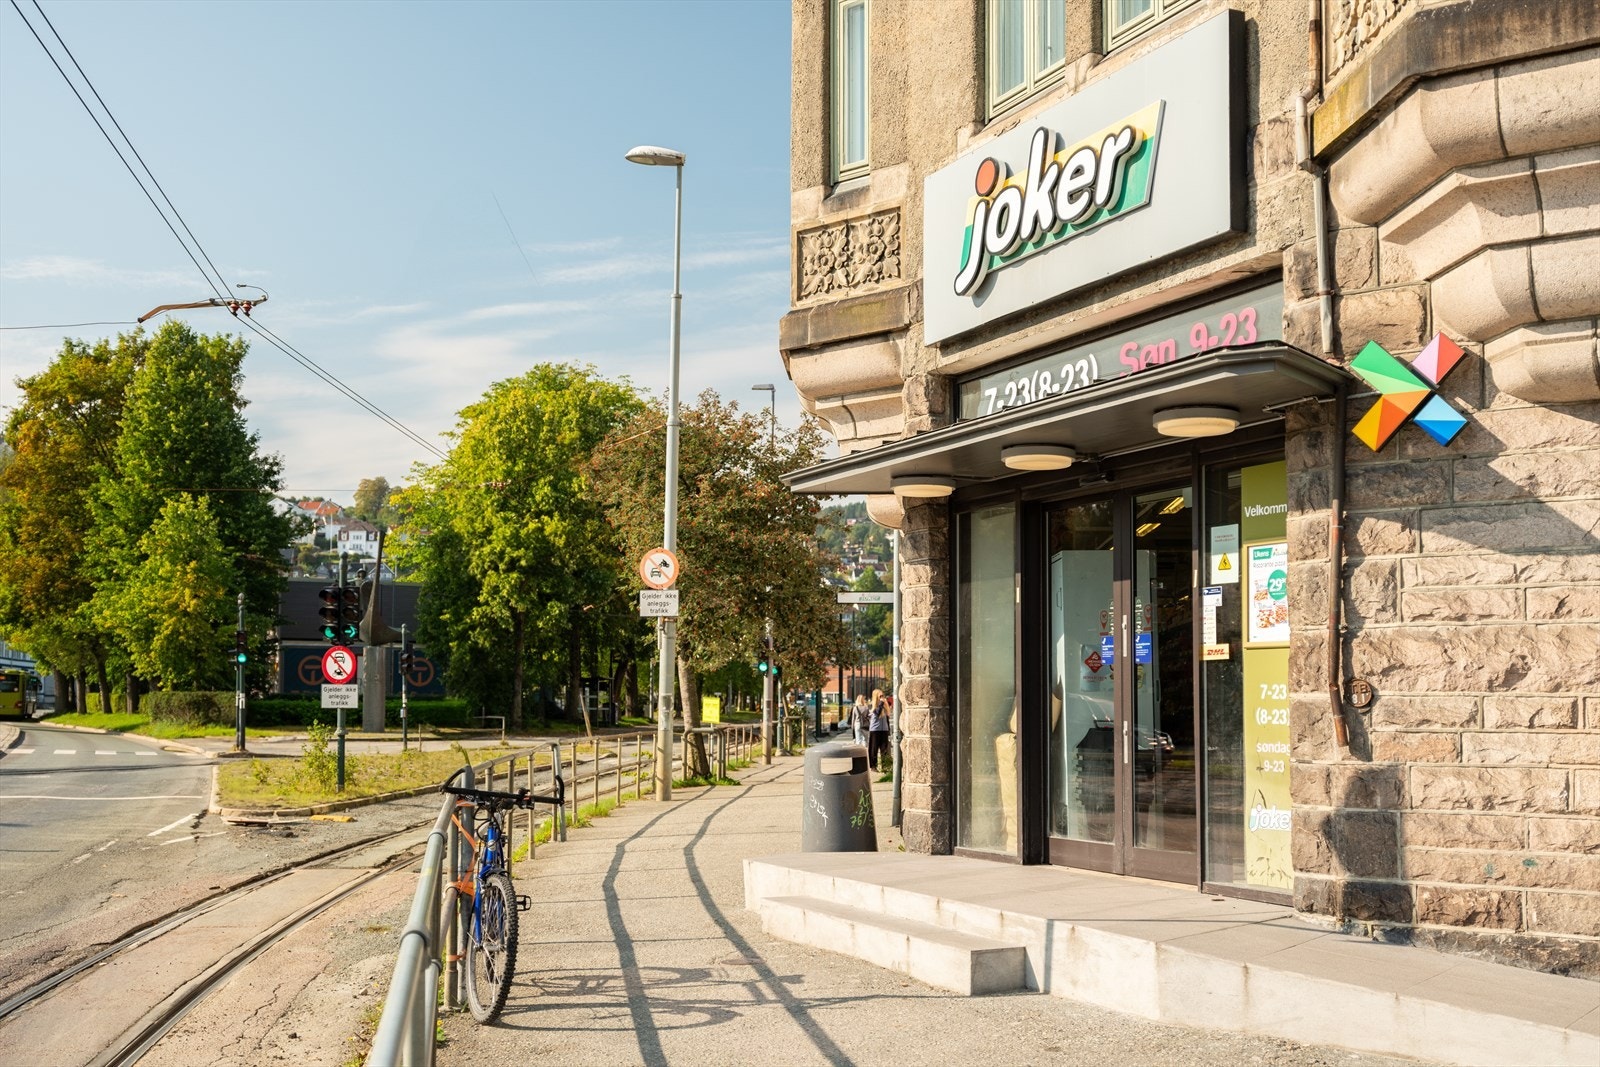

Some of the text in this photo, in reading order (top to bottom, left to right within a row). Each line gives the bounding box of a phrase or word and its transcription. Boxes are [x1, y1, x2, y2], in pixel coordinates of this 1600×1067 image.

[954, 126, 1140, 296] joker
[1189, 307, 1258, 351] 9-23
[1244, 503, 1287, 518] Velkomm
[1260, 683, 1287, 700] 7-23
[1255, 707, 1290, 726] (8-23)
[1264, 760, 1285, 773] 9-23
